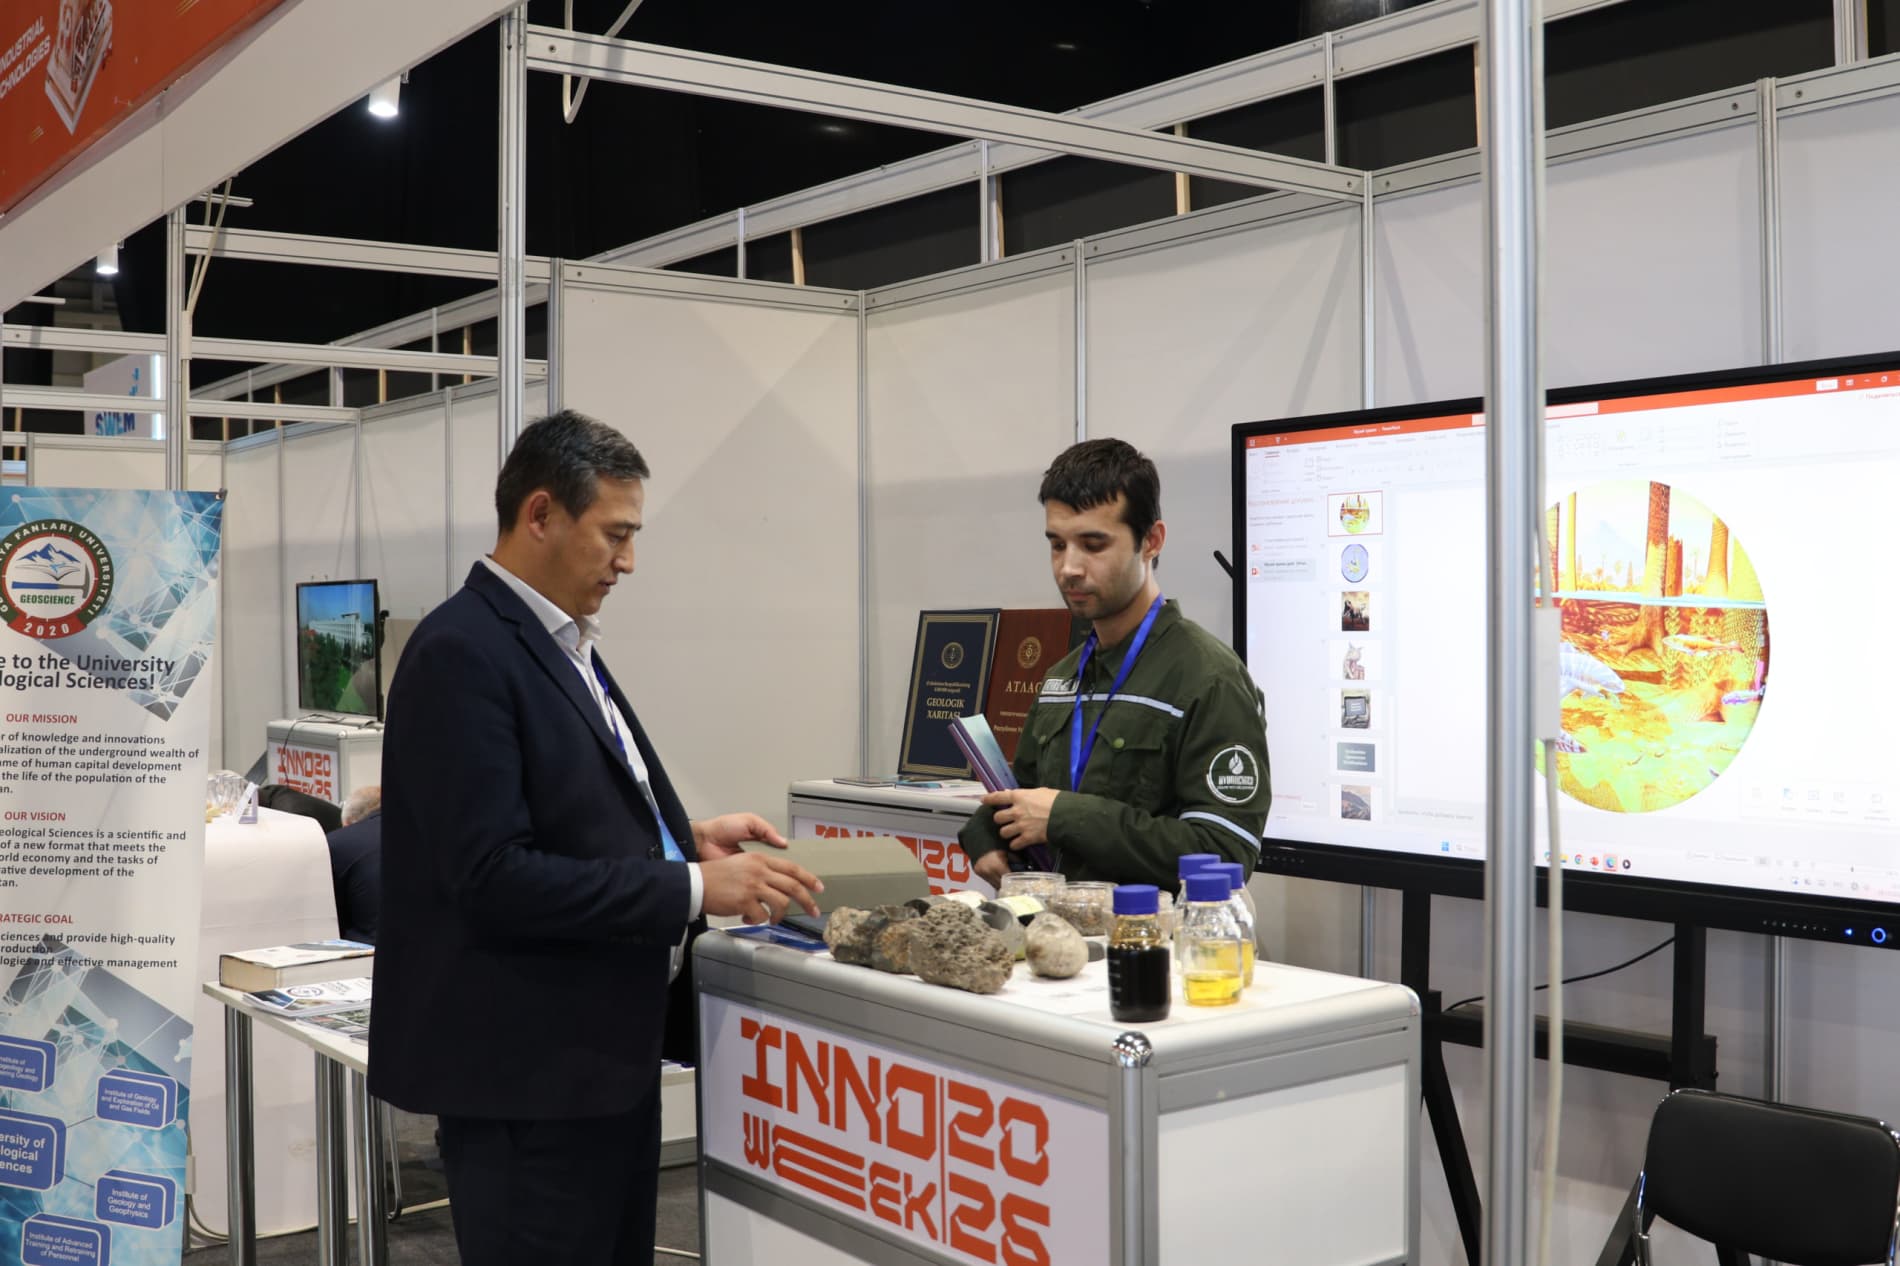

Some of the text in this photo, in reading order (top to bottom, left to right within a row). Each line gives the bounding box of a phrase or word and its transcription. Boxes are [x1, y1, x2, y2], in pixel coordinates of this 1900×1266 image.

[14, 523, 73, 540] FANLARI
[79, 531, 111, 615] UNIVERSITETI
[20, 594, 76, 605] GEOSCIENCE
[24, 622, 70, 636] 2020
[13, 655, 32, 669] to
[39, 653, 70, 669] the
[77, 654, 175, 676] University
[66, 672, 155, 690] Sciences!
[926, 697, 965, 708] GEOLOGIK
[6, 713, 78, 724] OUR MISSION
[8, 732, 20, 742] of
[22, 732, 79, 745] knowledge
[82, 733, 101, 743] and
[104, 734, 165, 745] innovations
[45, 746, 56, 756] of
[58, 746, 76, 756] the
[79, 747, 147, 760] underground
[150, 748, 186, 758] wealth
[188, 748, 200, 758] of
[21, 758, 33, 768] of
[35, 758, 72, 769] human
[75, 759, 110, 771] capital
[112, 760, 181, 773] development
[2, 772, 166, 785] the life of the population of the
[4, 811, 66, 822] OUR VISION
[48, 829, 94, 839] Sciences
[96, 830, 104, 839] is
[116, 830, 163, 840] scientific
[166, 831, 186, 840] and
[1, 840, 12, 850] of
[48, 841, 84, 851] format
[88, 842, 109, 852] that
[112, 843, 146, 852] meets
[148, 843, 166, 852] the
[22, 856, 70, 866] economy
[73, 854, 93, 864] and
[96, 854, 114, 864] the
[117, 855, 144, 865] tasks
[146, 856, 158, 866] of
[0, 866, 134, 878] ative development of the
[44, 914, 74, 924] GOAL
[42, 932, 63, 942] and
[66, 933, 108, 945] provide
[110, 934, 176, 946] high-quality
[34, 956, 54, 967] and
[58, 957, 104, 968] effective
[106, 960, 178, 970] management
[741, 1016, 1050, 1187] INNO 20
[33, 1138, 46, 1149] of
[743, 1111, 939, 1241] WEEK
